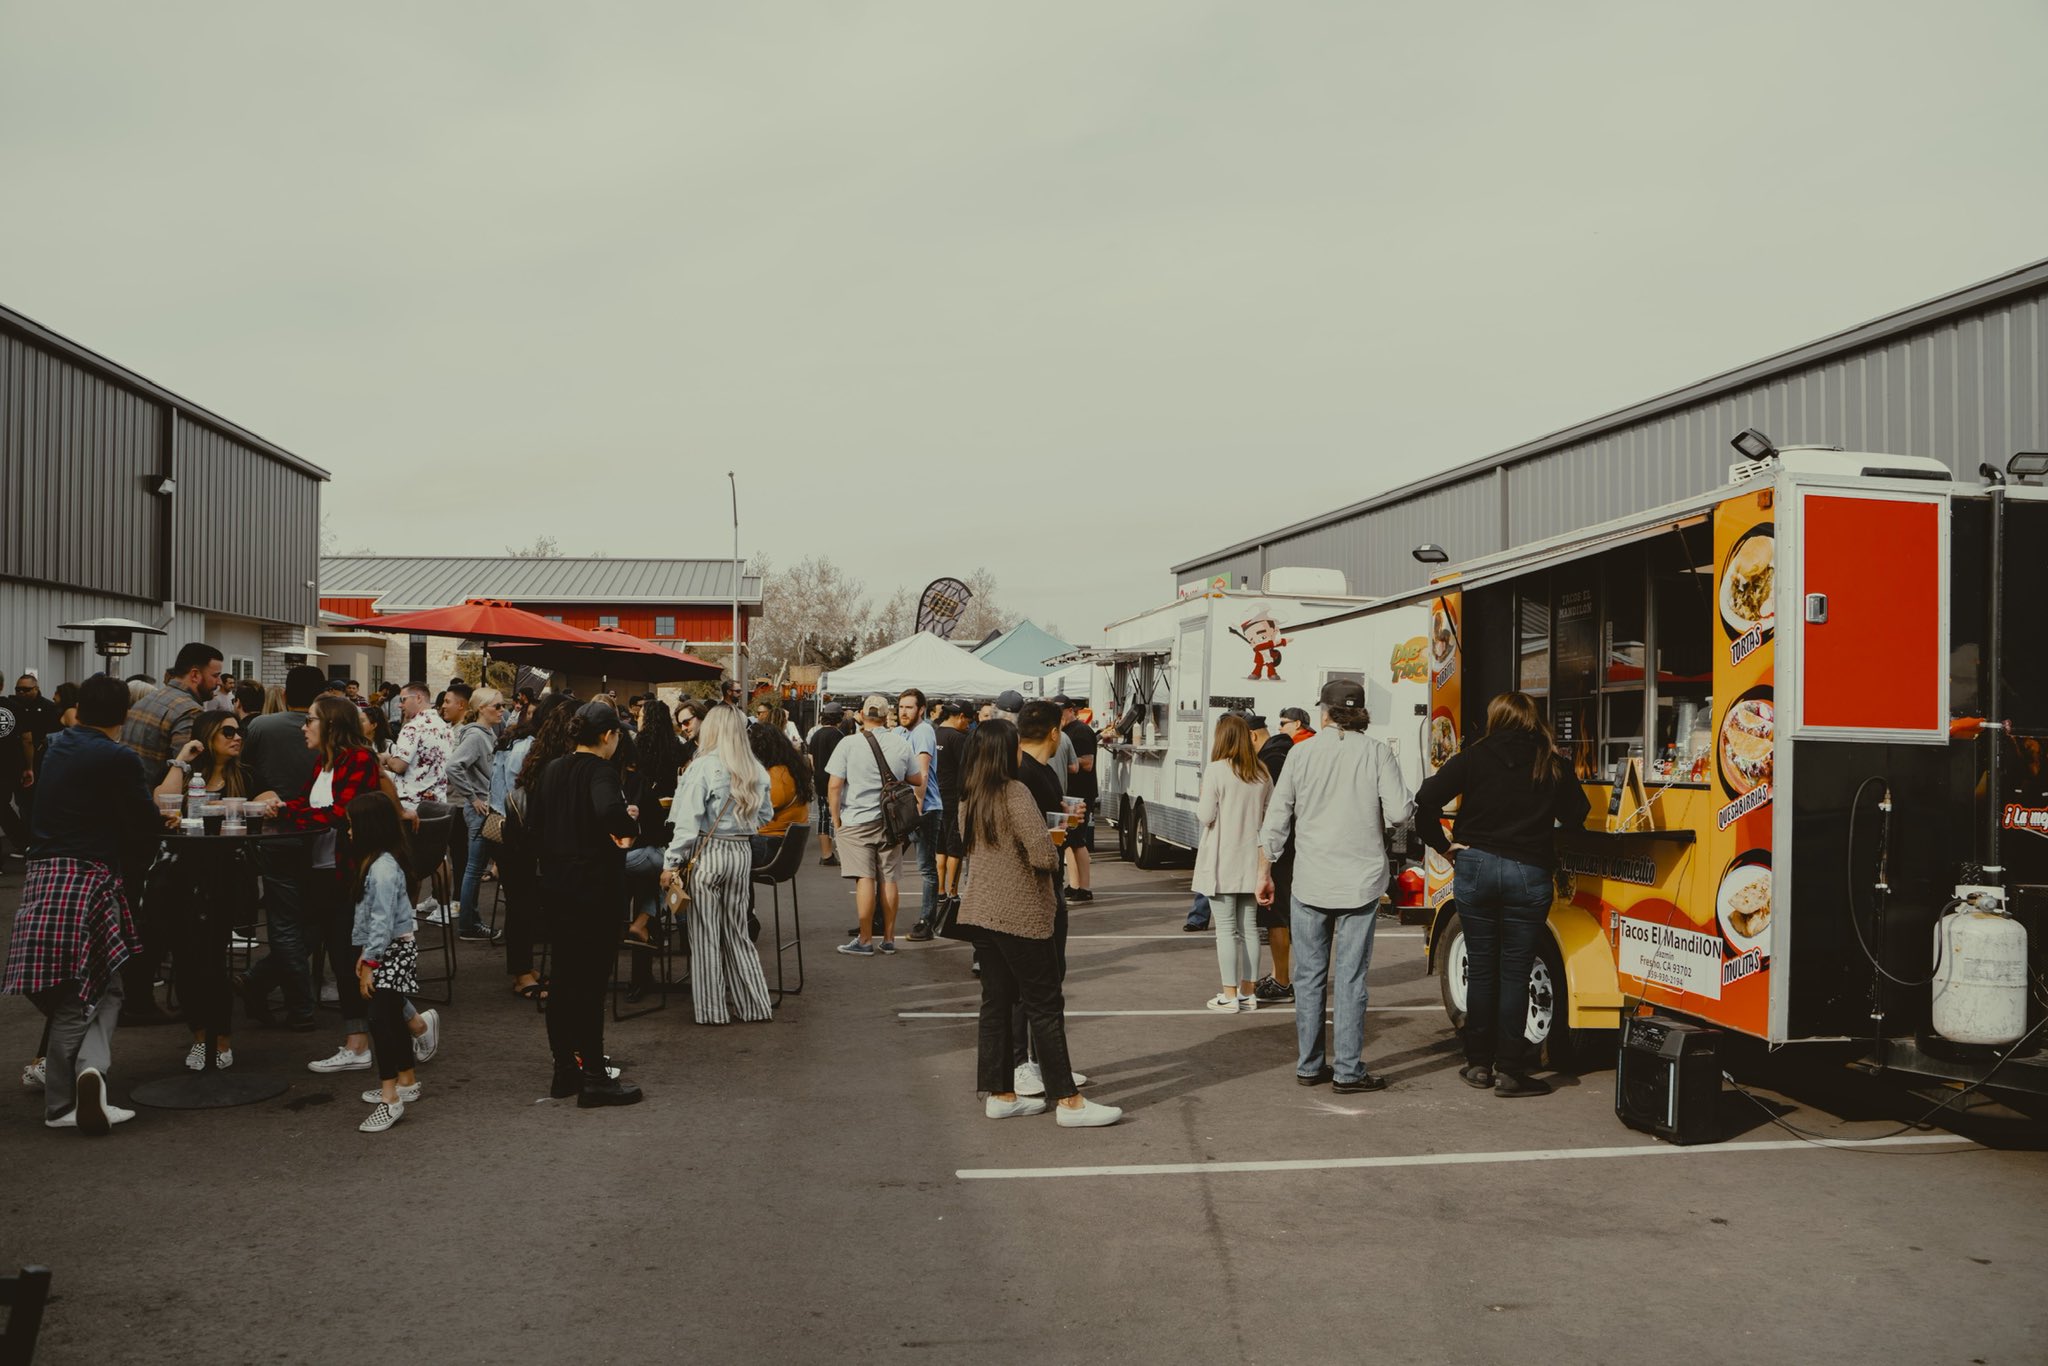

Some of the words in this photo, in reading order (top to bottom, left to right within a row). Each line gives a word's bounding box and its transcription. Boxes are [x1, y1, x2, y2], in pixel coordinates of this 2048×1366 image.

[1731, 626, 1760, 664] TORTAS
[1719, 784, 1767, 829] QUESABIRRIAS
[1610, 855, 1655, 885] domicilio
[1621, 919, 1649, 942] Tacos
[1652, 926, 1661, 945] El
[1664, 929, 1722, 959] MandilON
[1663, 960, 1671, 971] CA
[1673, 962, 1692, 978] 93702
[1724, 950, 1760, 984] MULITAS
